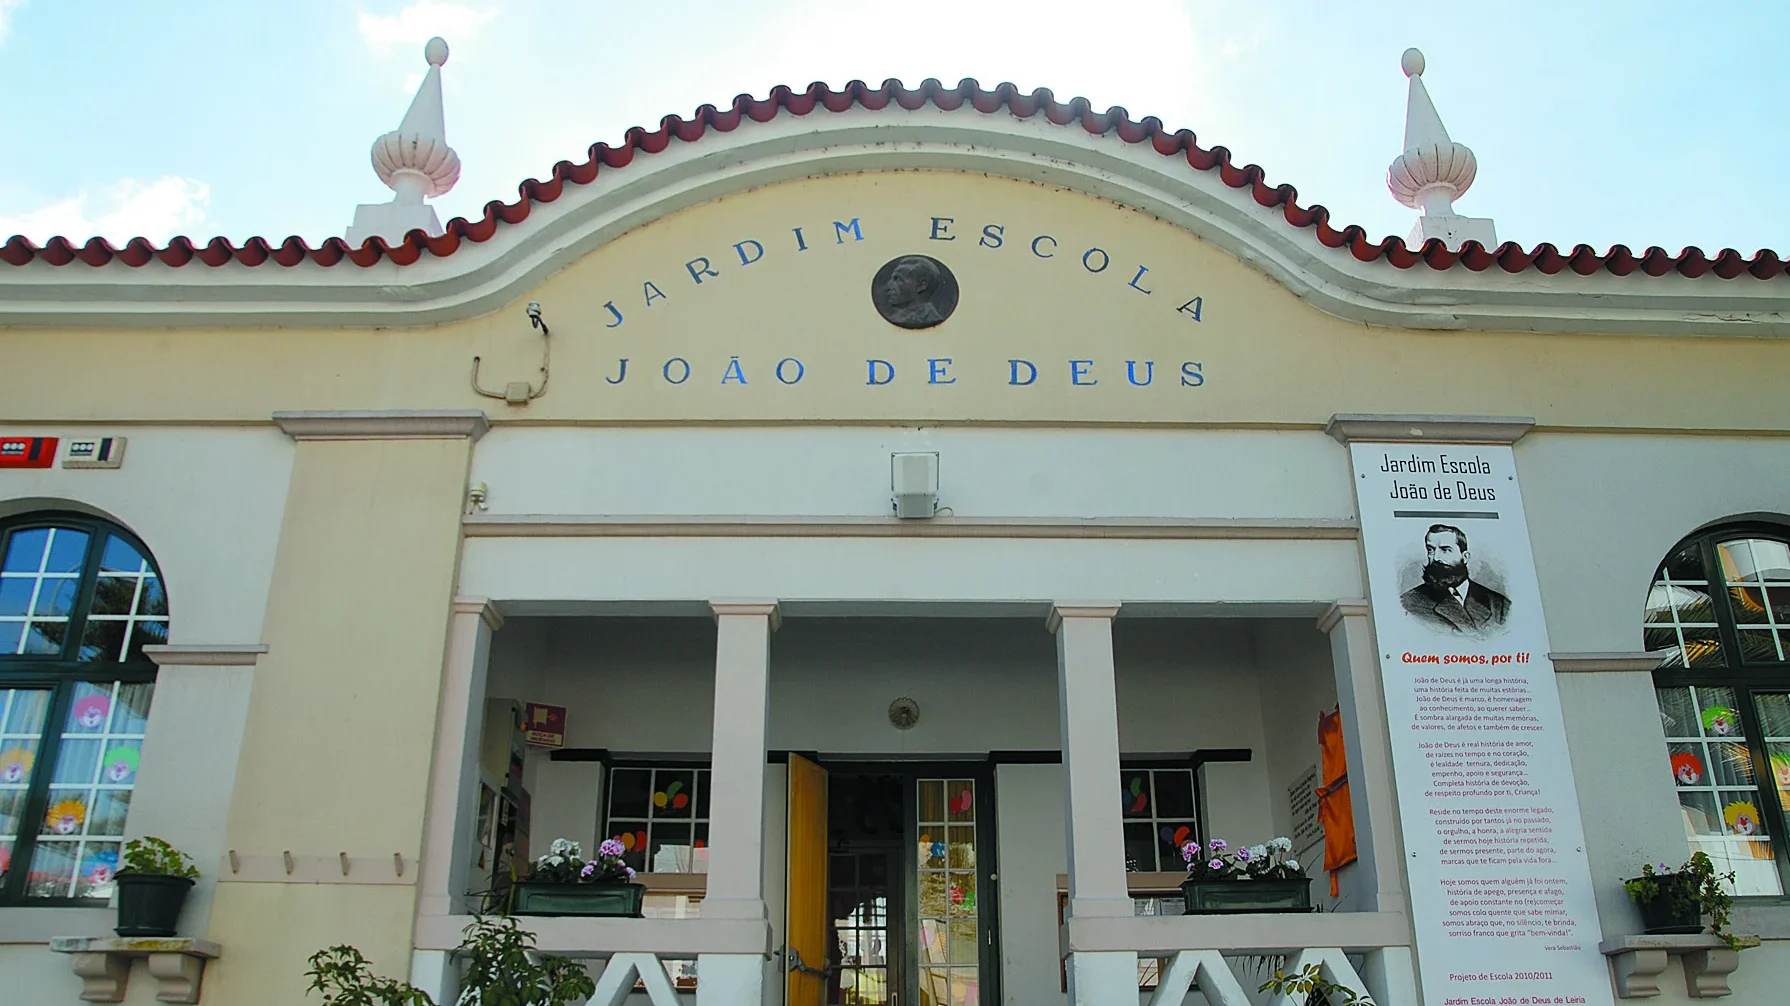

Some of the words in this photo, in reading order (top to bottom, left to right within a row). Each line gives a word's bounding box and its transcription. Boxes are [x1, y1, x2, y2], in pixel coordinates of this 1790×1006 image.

[603, 217, 866, 329] JARDIM
[929, 216, 1205, 323] ESCOLA
[605, 356, 806, 386] JOÃO
[866, 357, 957, 386] DE
[1008, 359, 1205, 387] DEUS
[1381, 454, 1435, 473] Jardim
[1441, 455, 1491, 474] Escola
[1390, 480, 1428, 500] João
[1434, 482, 1452, 500] de
[1457, 481, 1496, 501] Deus
[1401, 652, 1440, 664] Quem
[1443, 653, 1488, 665] somos,
[1492, 653, 1512, 665] por
[1516, 652, 1530, 664] ti!
[1501, 779, 1529, 787] devoção,
[1462, 789, 1493, 797] profundo
[1443, 828, 1471, 836] orgulho,
[1501, 878, 1525, 886] alguém
[1527, 878, 1533, 886] já
[1544, 888, 1564, 896] afago,
[1460, 899, 1479, 907] apoio
[1450, 974, 1477, 982] Projeto
[1515, 972, 1553, 980] 2010/2011
[1498, 997, 1517, 1005] João
